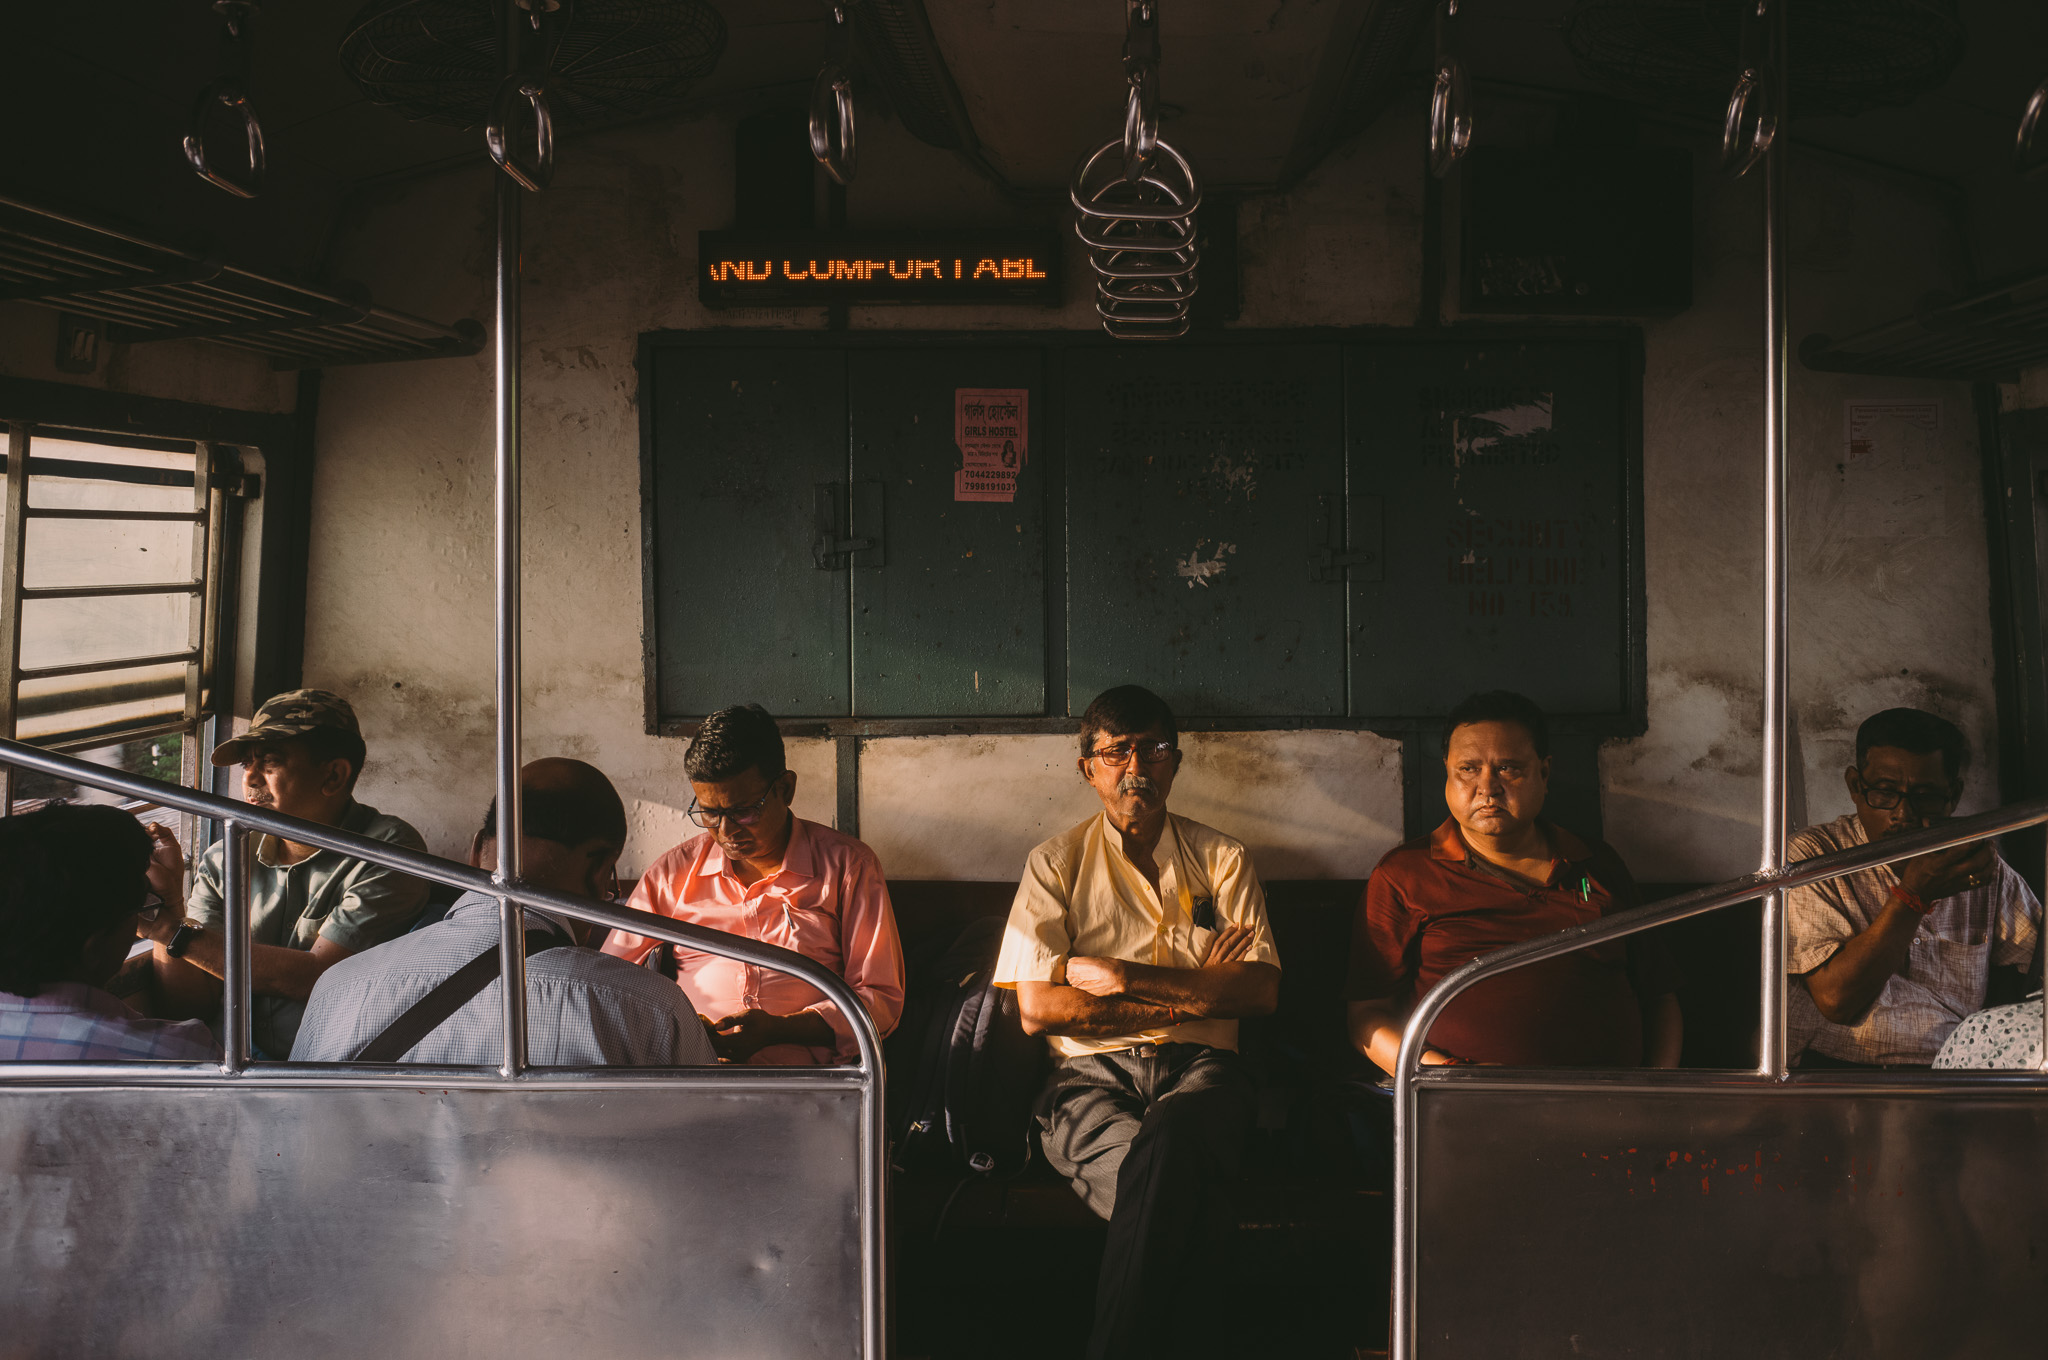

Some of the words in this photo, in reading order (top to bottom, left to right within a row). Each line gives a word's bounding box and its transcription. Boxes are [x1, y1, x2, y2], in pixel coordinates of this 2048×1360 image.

[711, 260, 772, 281] ND
[964, 426, 987, 436] GIRLS
[988, 426, 1018, 437] HOSTEL
[1420, 442, 1561, 467] PRHIBITED
[965, 470, 1016, 479] 7044229892
[965, 482, 1016, 491] 7998191031
[1446, 519, 1587, 549] SECURITY
